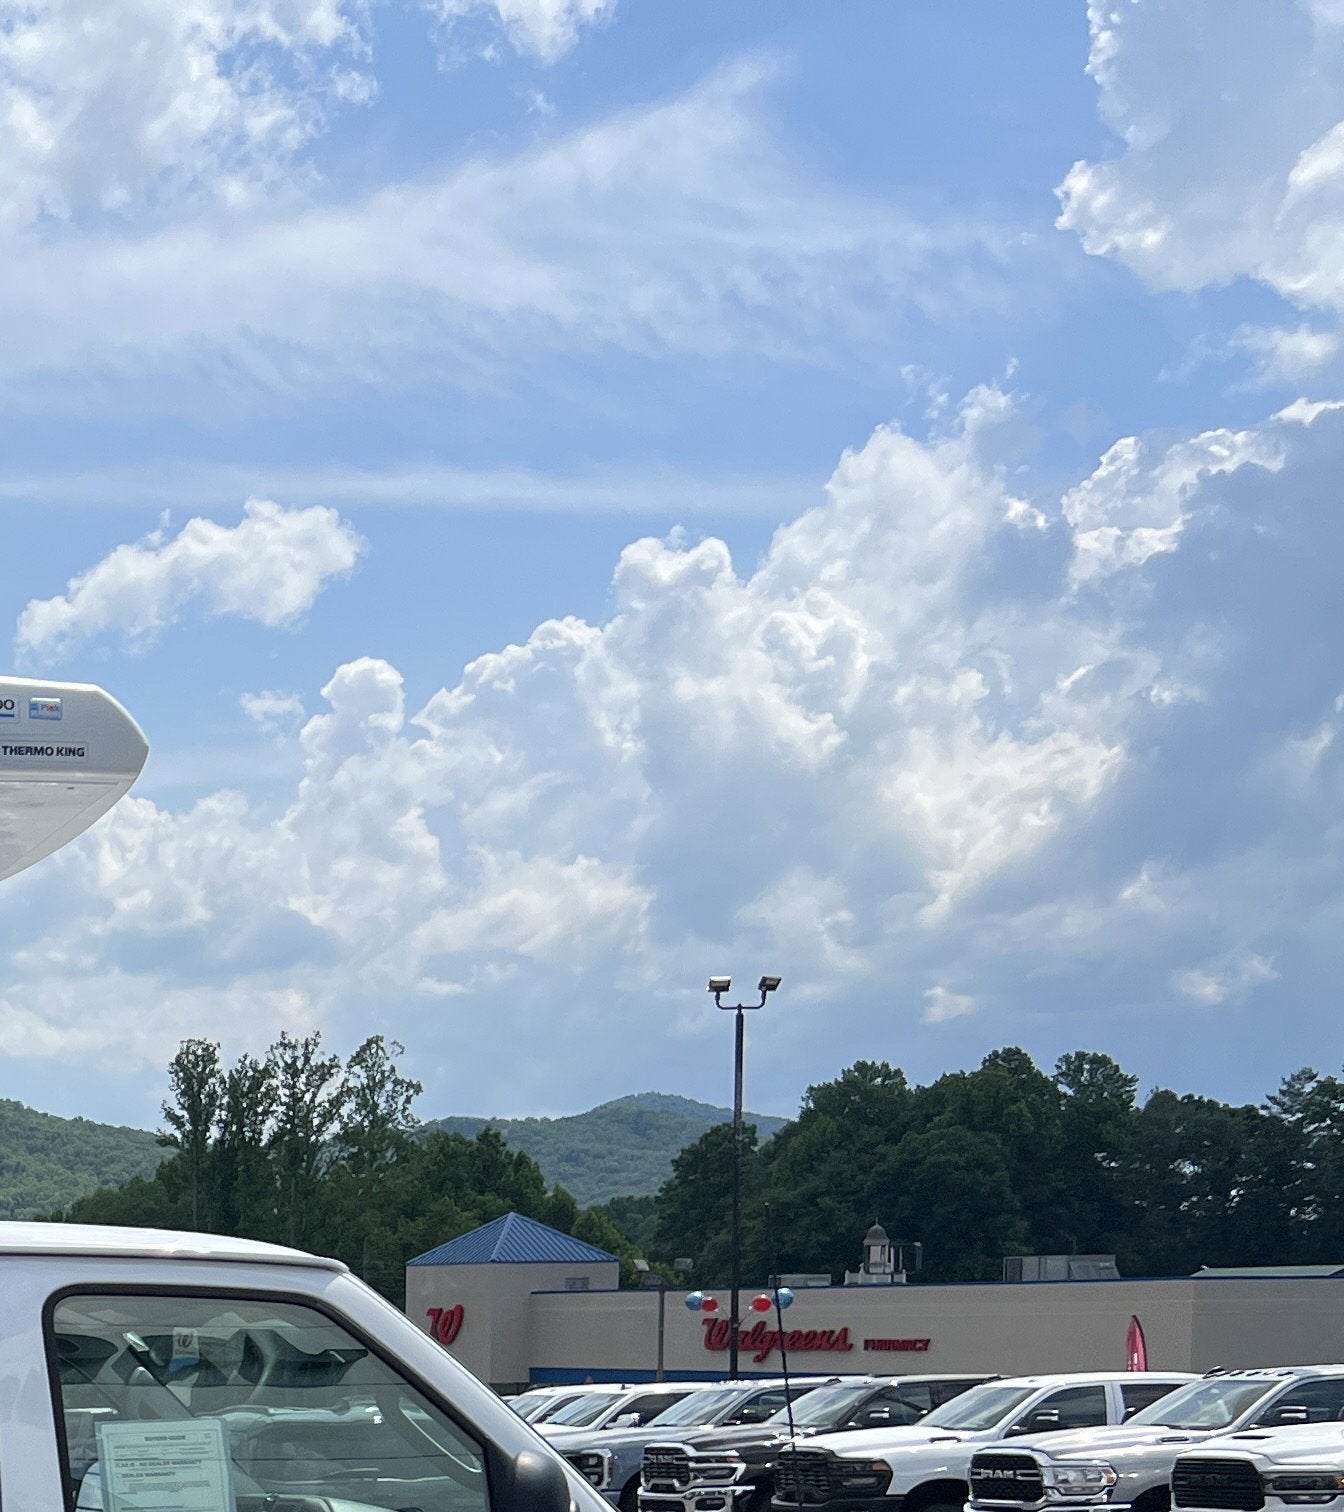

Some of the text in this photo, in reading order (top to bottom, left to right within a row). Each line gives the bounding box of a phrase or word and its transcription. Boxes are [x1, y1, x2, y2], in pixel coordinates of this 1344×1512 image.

[1, 745, 85, 757] THERMO KING
[426, 1304, 464, 1345] W
[702, 1318, 854, 1363] Walgreens
[981, 1469, 1014, 1478] RAM
